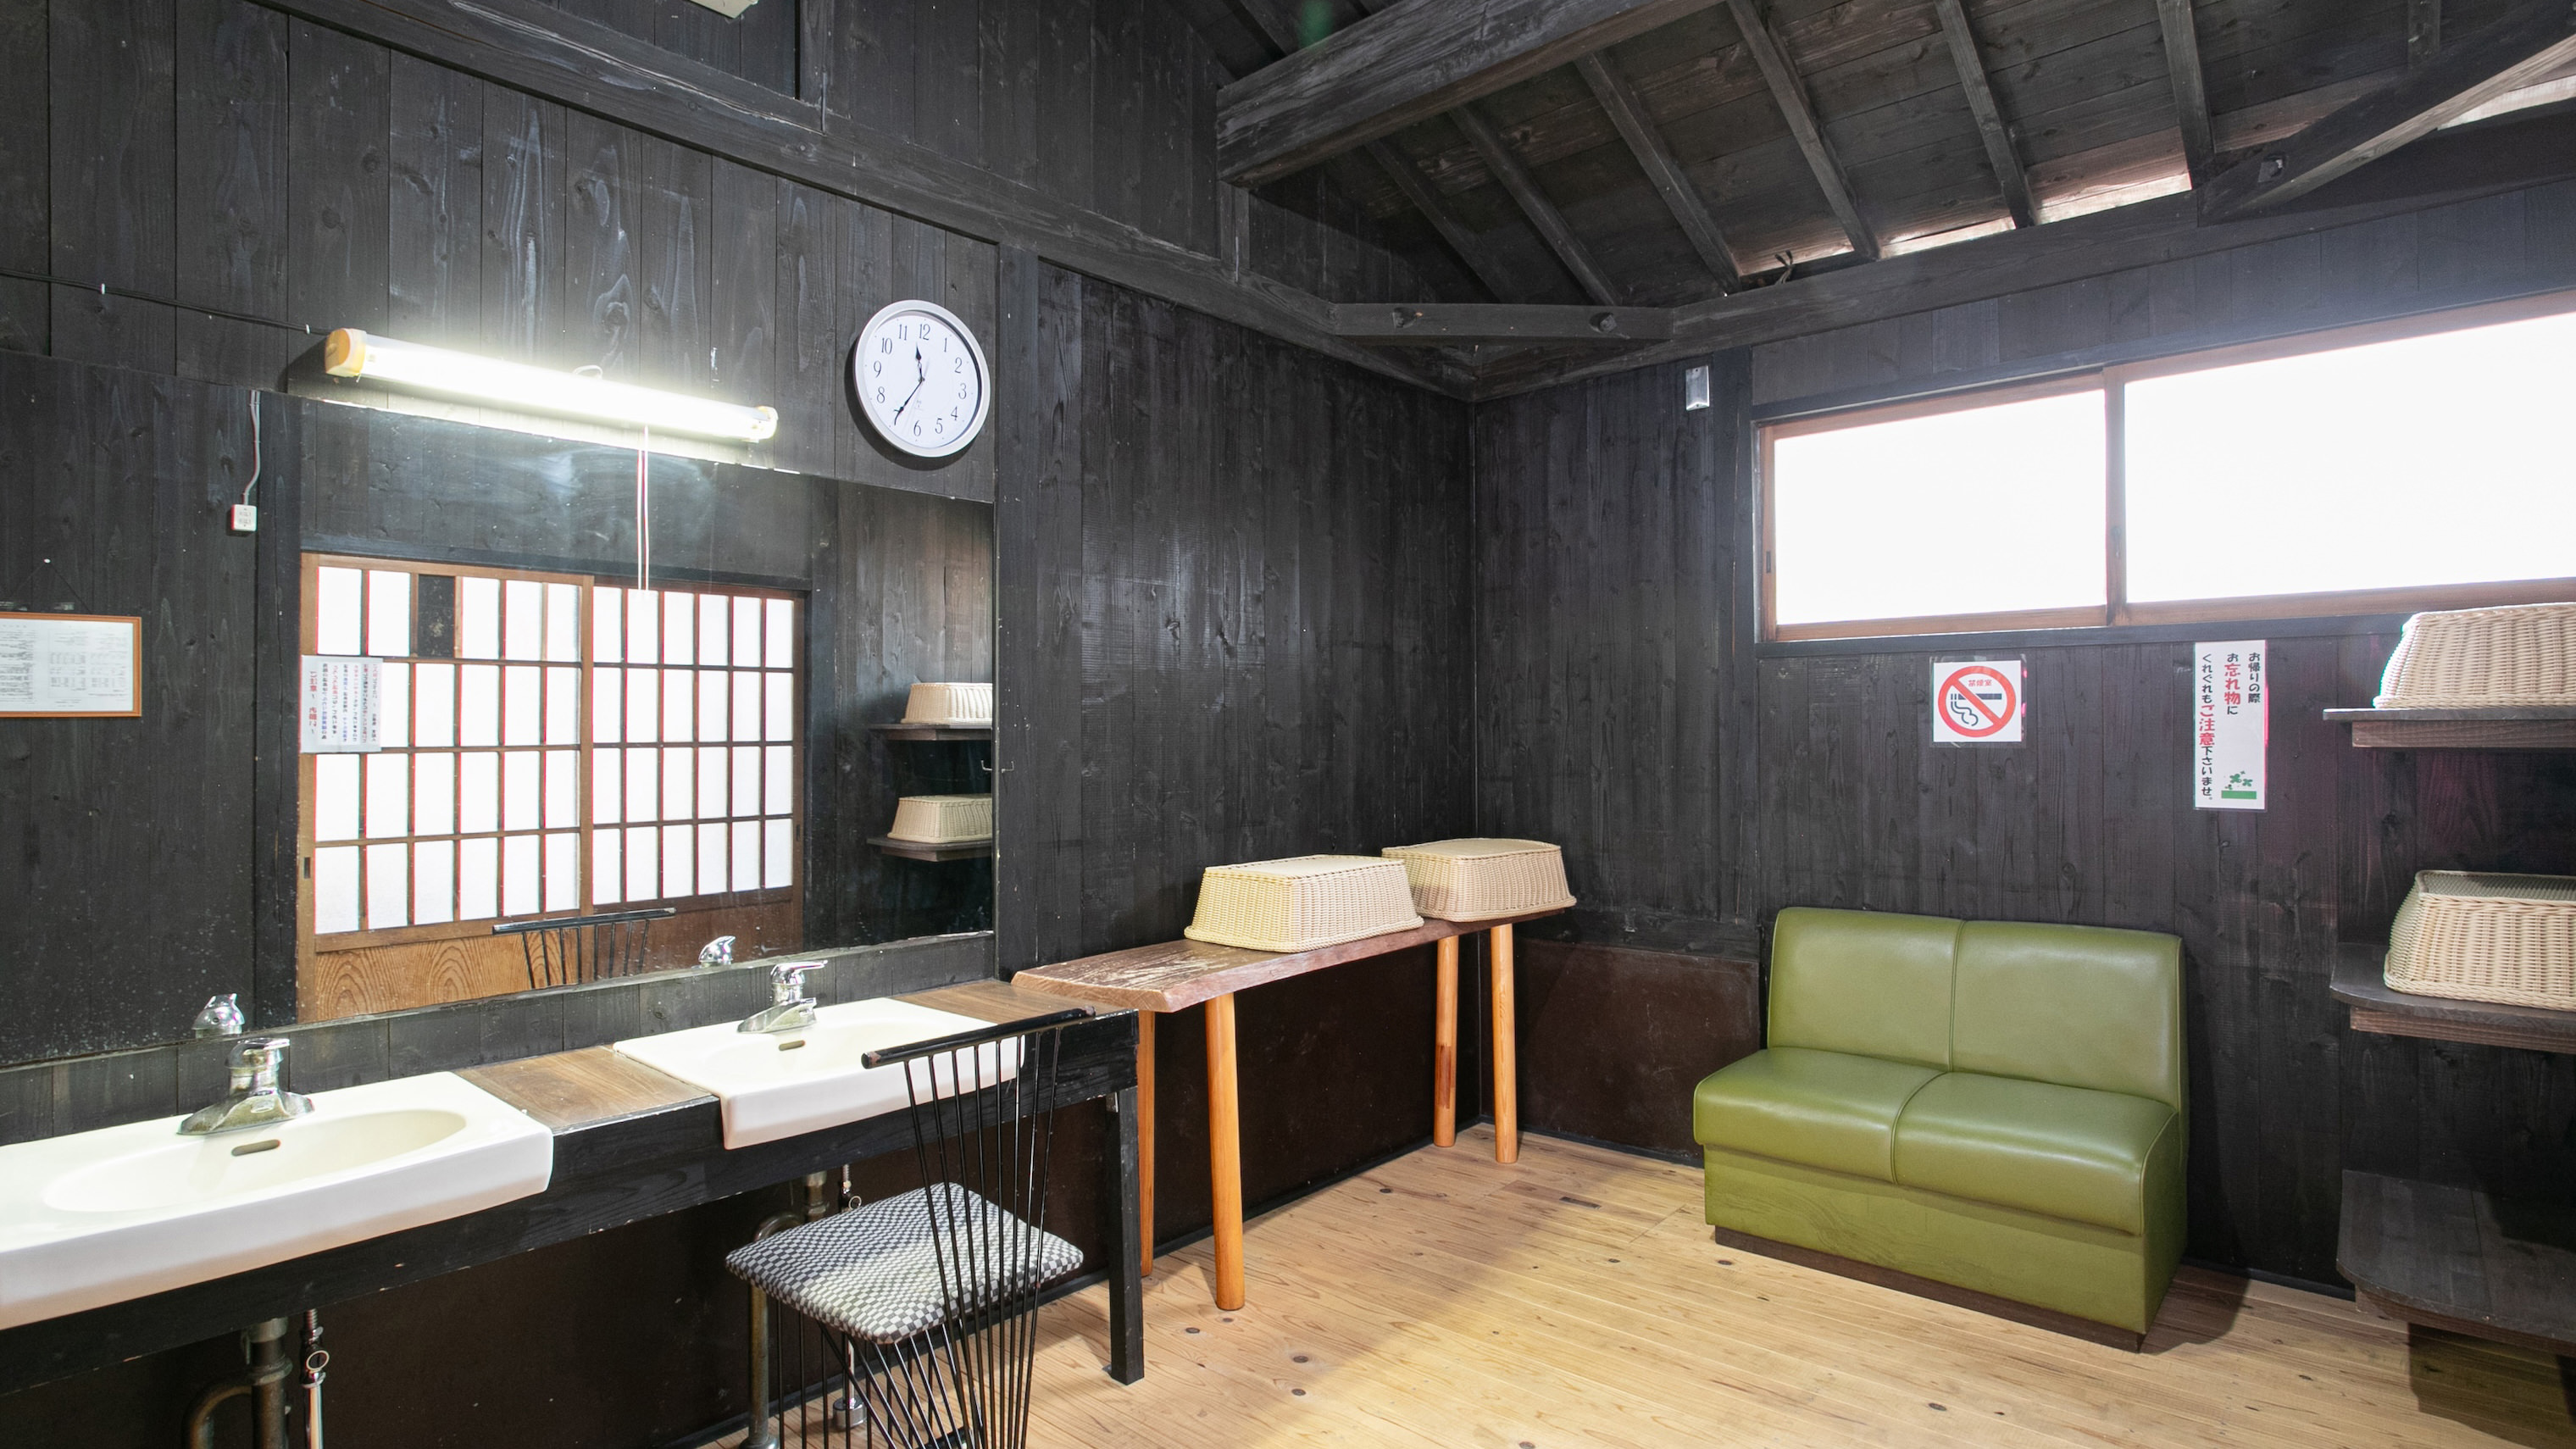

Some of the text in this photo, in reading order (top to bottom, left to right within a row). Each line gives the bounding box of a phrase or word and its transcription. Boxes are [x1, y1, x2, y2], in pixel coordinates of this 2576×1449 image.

[898, 324, 908, 341] 11
[919, 324, 930, 341] 12
[881, 338, 892, 354] 10
[944, 337, 947, 353] 1
[874, 360, 881, 378] 9
[955, 358, 963, 374] 2
[877, 386, 885, 403] 8
[958, 383, 967, 399] 3
[951, 407, 958, 420] 4
[913, 420, 921, 436] 6
[935, 419, 943, 434] 5
[2224, 653, 2240, 715] お忘れ物に
[2248, 652, 2261, 703] お帰りの際
[2199, 653, 2215, 800] くれぐれもご注意下さいませ。
